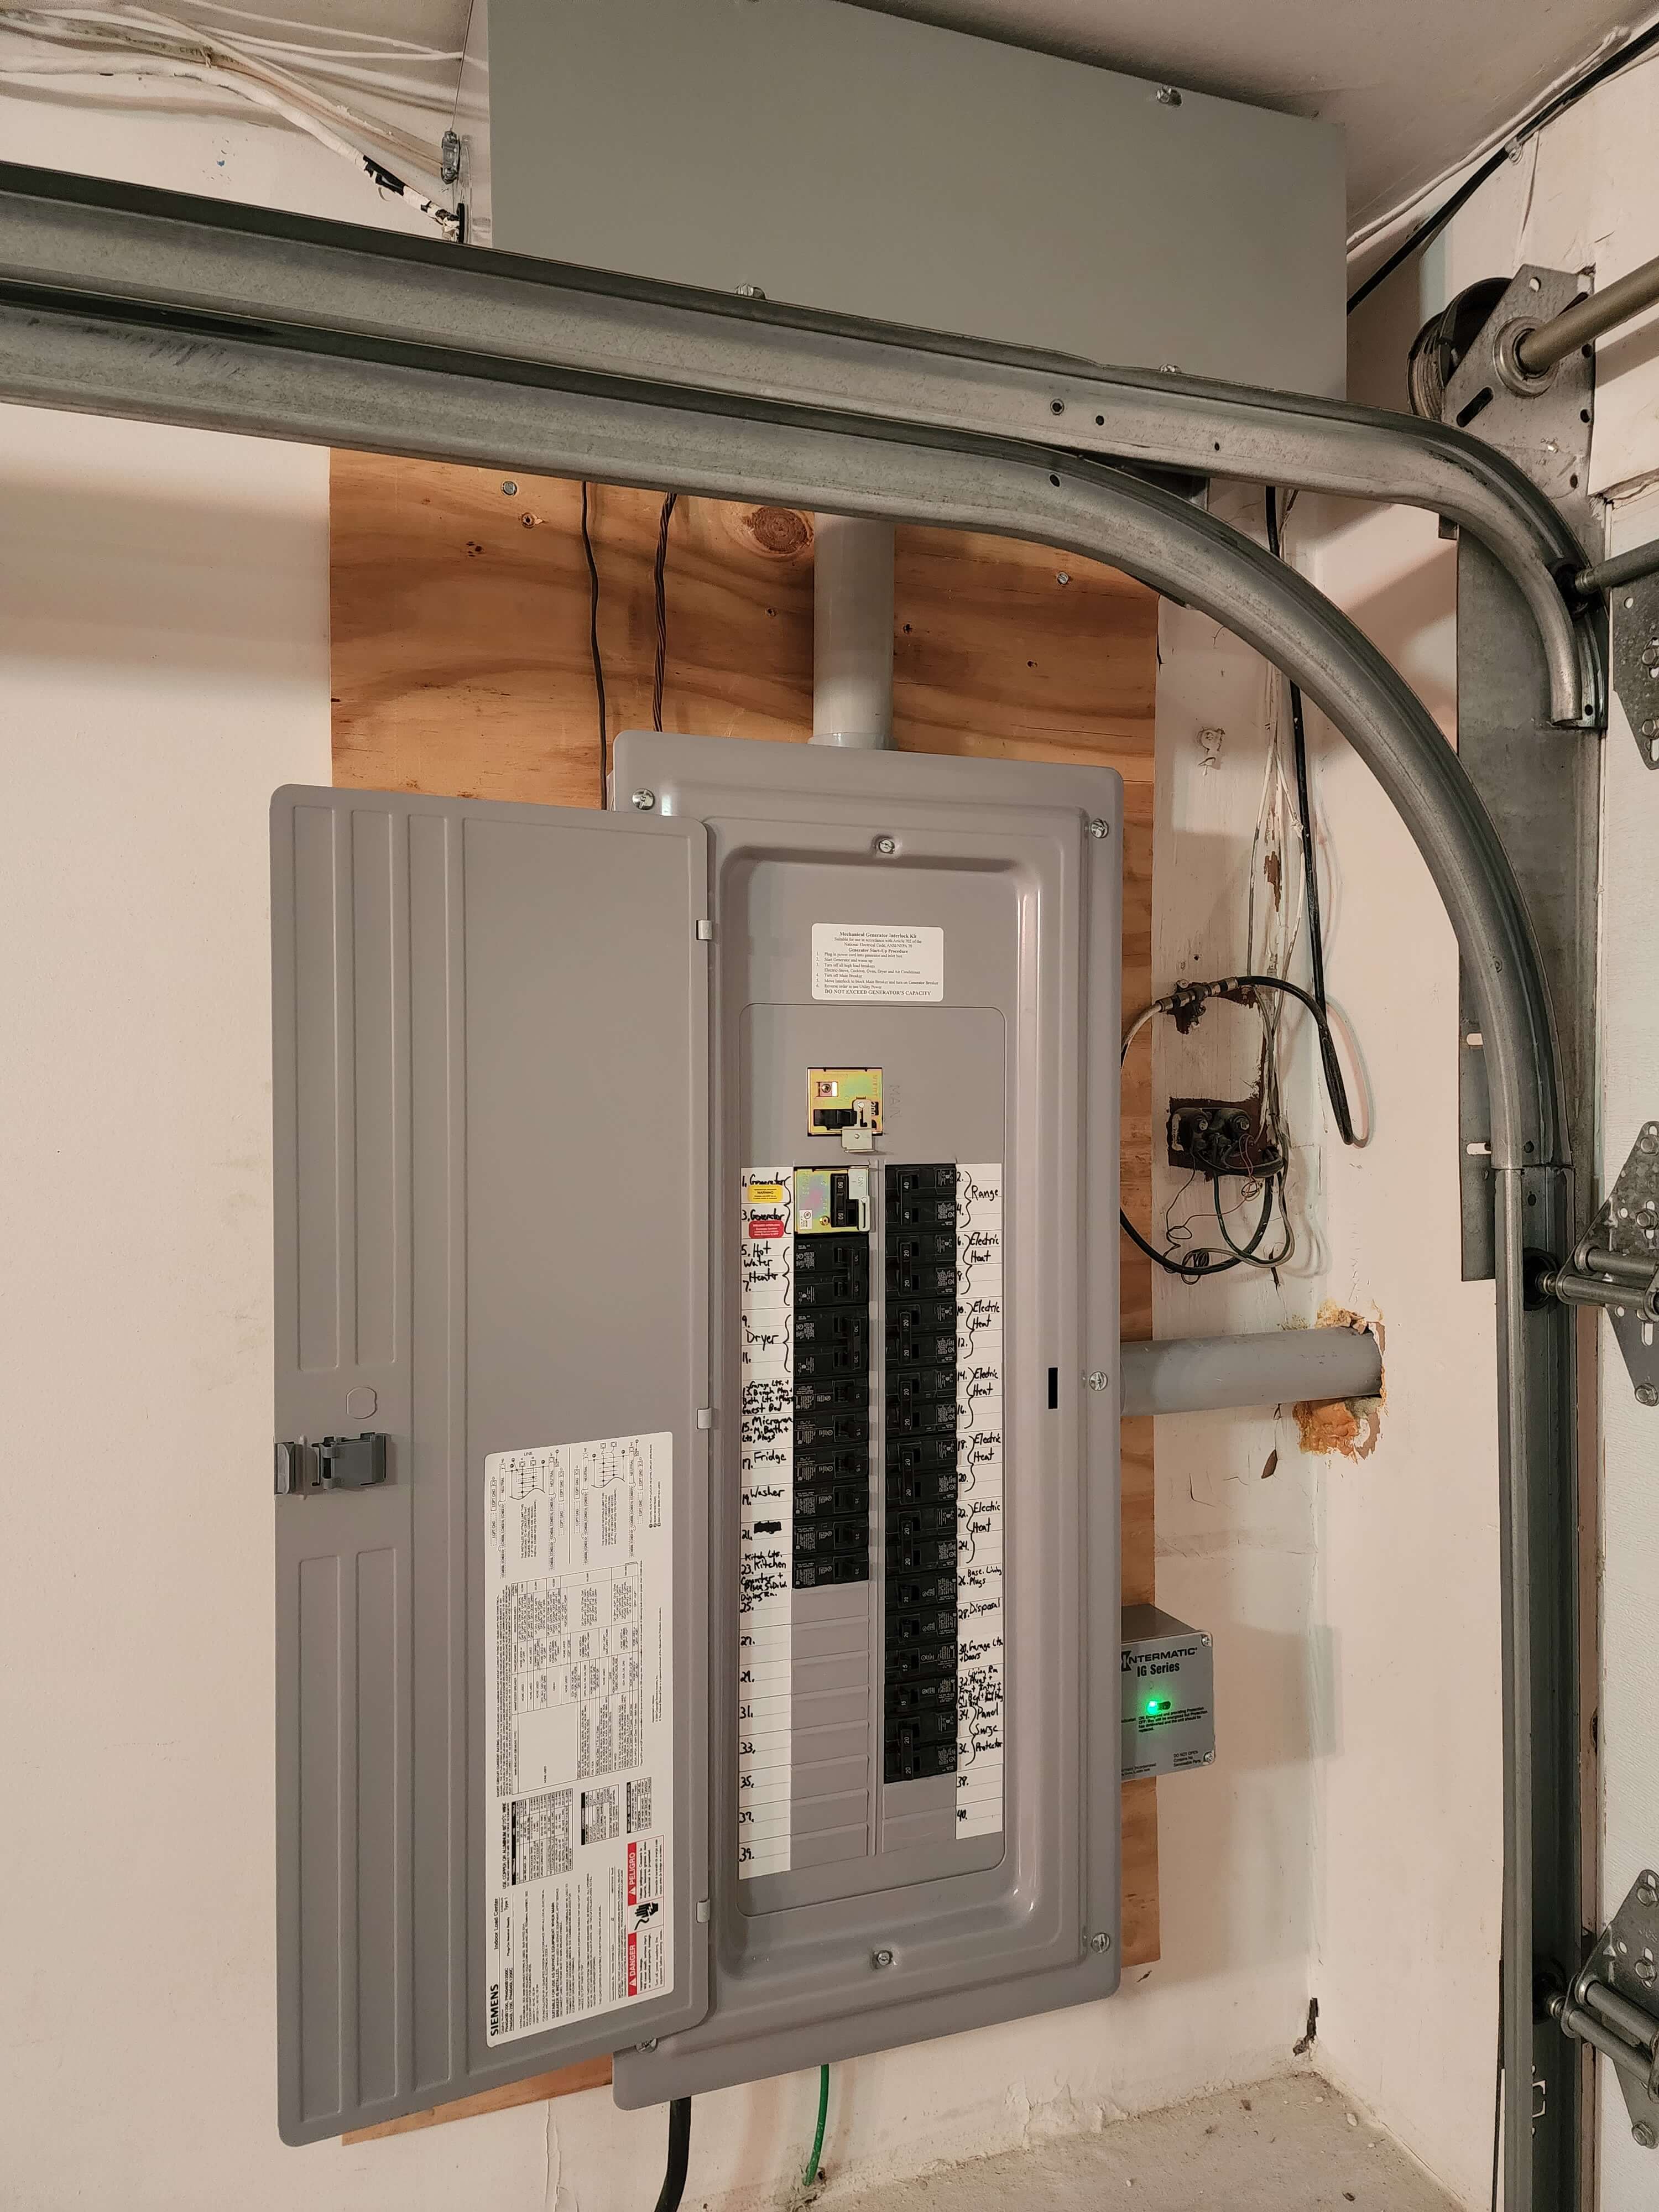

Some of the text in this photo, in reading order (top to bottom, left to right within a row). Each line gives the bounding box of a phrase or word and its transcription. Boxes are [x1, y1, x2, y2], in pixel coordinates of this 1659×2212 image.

[957, 1171, 964, 1182] 2.
[971, 1185, 999, 1201] Range
[837, 1212, 844, 1220] 50
[957, 1203, 964, 1216] 4.
[957, 1235, 964, 1246] 6.
[969, 1232, 999, 1246] Electric
[741, 1240, 771, 1256] 5. Hot
[743, 1280, 752, 1292] 7.
[972, 1299, 1000, 1313] Electric
[742, 1315, 750, 1328] 9.
[903, 1319, 909, 1327] 20
[972, 1313, 992, 1328] Heat
[745, 1329, 779, 1351] Dryer
[958, 1337, 968, 1348] 12.
[742, 1352, 752, 1364] 11.
[957, 1371, 967, 1381] 14.
[972, 1382, 994, 1396] Heat
[957, 1404, 967, 1415] 16.
[904, 1418, 910, 1426] 20
[958, 1439, 968, 1452] 18.
[754, 1449, 787, 1464] Fridge
[973, 1447, 994, 1463] Heat
[750, 1486, 785, 1498] Washer
[958, 1501, 1000, 1518] 22. Electric
[972, 1517, 991, 1533] Heat
[741, 1556, 786, 1575] 23. Kitchen
[740, 1601, 754, 1613] 25.
[969, 1597, 1000, 1616] Disposal
[1121, 1647, 1196, 1672] INTERMATIC
[902, 1664, 908, 1672] 15
[1137, 1662, 1180, 1677] IG Series
[957, 1809, 968, 1822] 40.
[490, 1984, 499, 2036] SIEMENS
